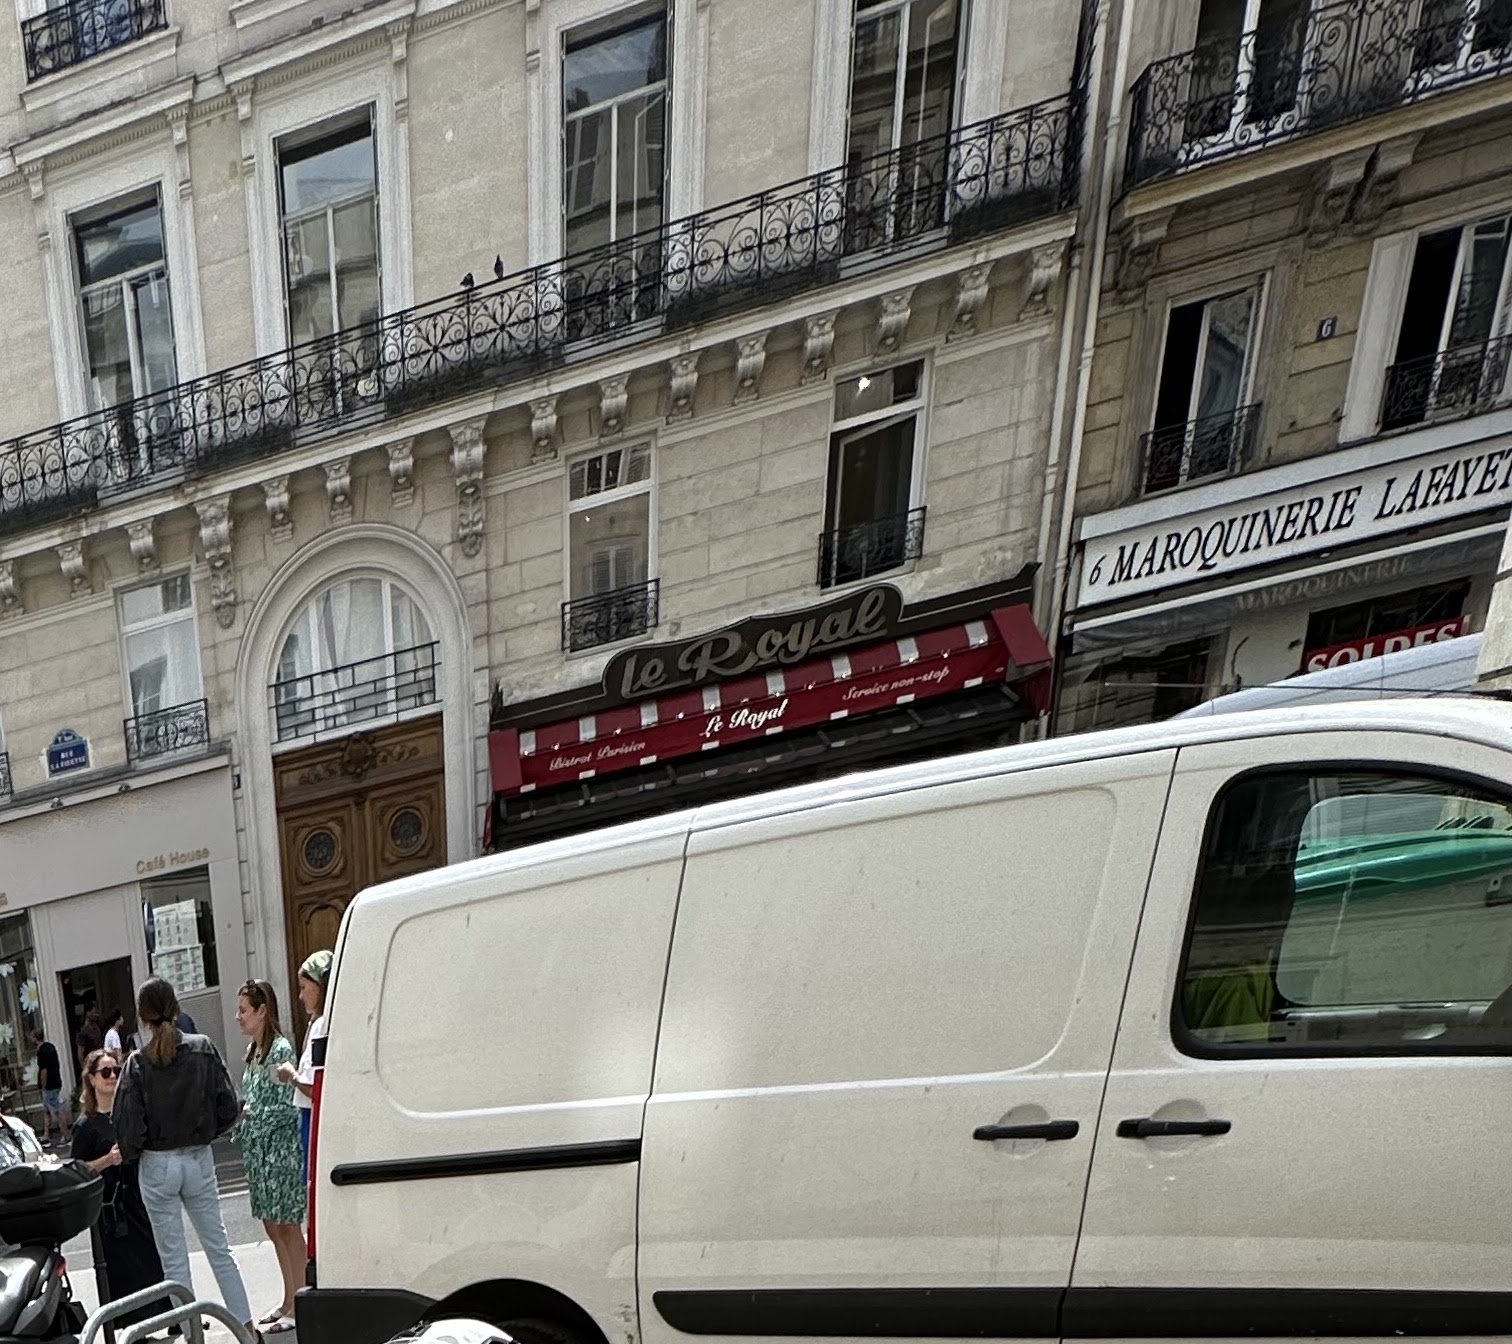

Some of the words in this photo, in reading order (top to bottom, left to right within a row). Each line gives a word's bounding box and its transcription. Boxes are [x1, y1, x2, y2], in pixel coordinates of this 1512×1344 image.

[1322, 319, 1333, 338] 6
[1089, 554, 1107, 586] 6
[1108, 485, 1363, 586] MAROQUINERIE
[678, 588, 888, 682] Royal
[842, 682, 890, 700] Service
[890, 665, 950, 690] non-stop
[699, 715, 724, 738] Le
[729, 698, 789, 730] Royal
[136, 853, 166, 875] Café
[169, 847, 210, 867] House
